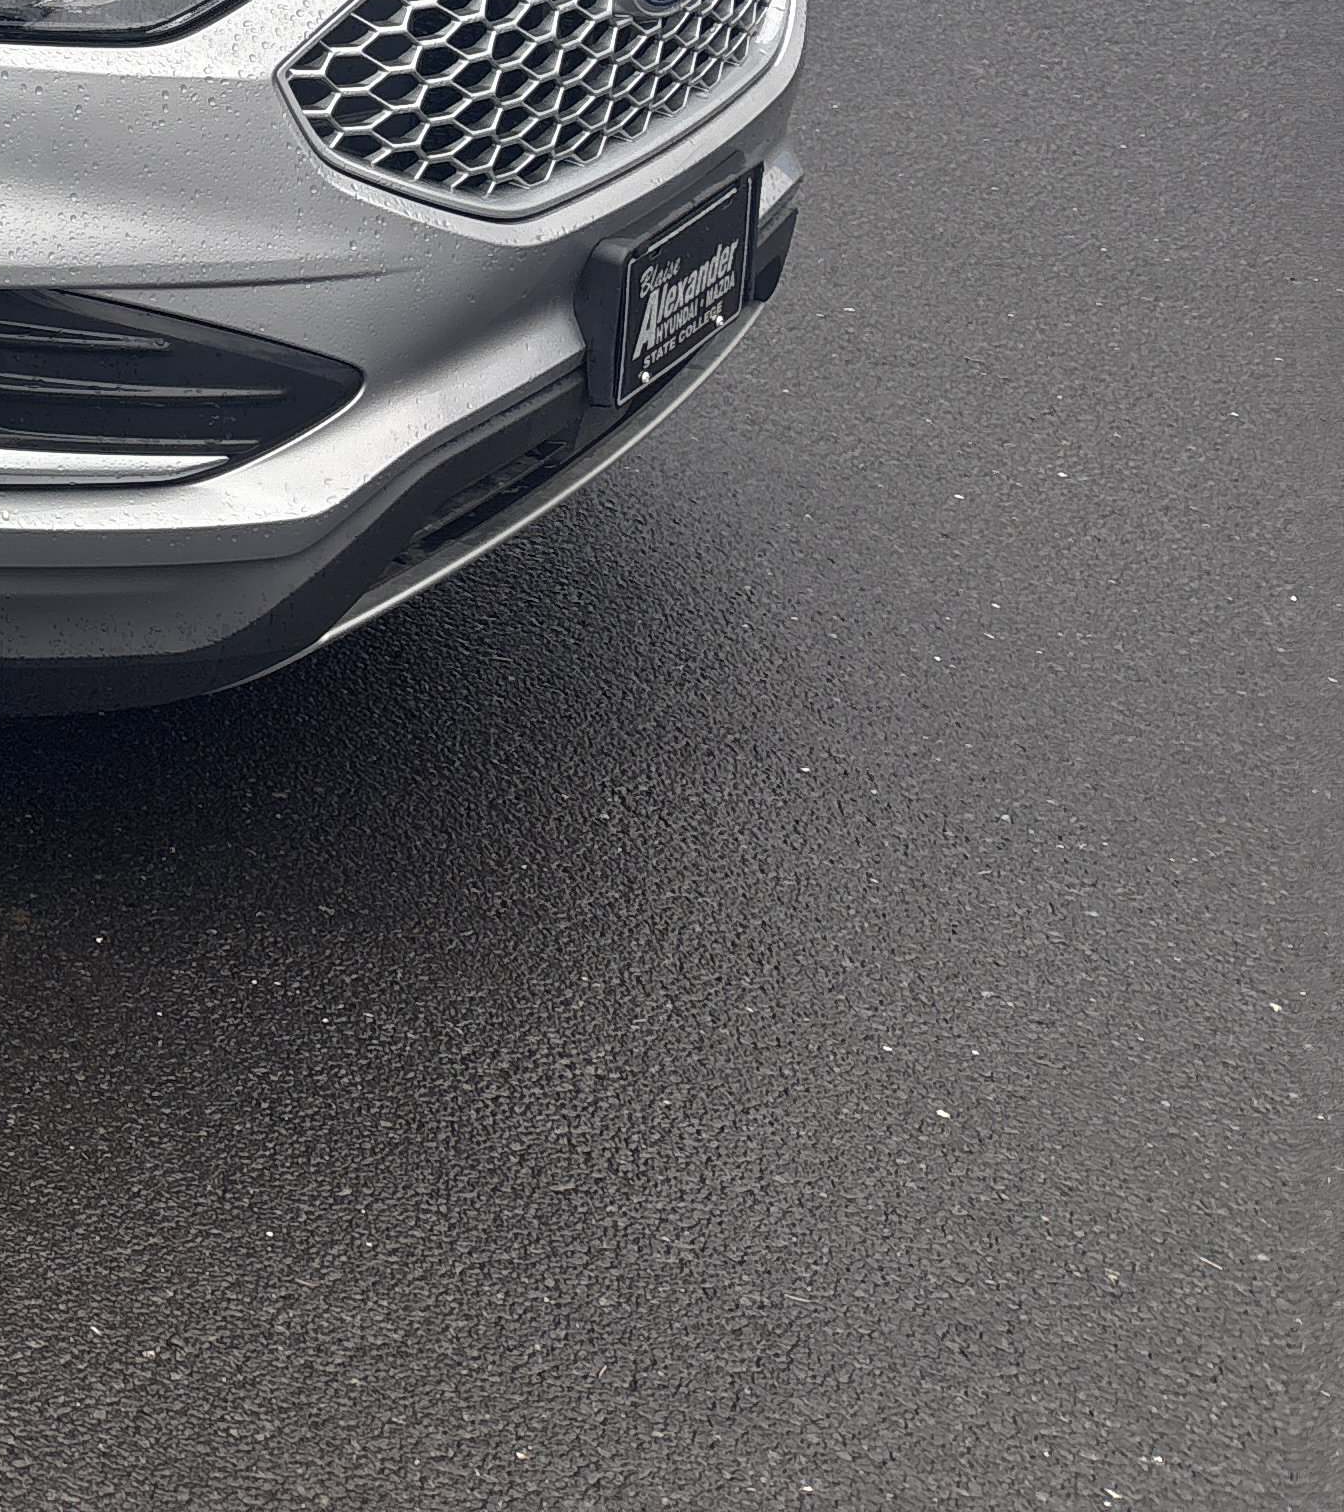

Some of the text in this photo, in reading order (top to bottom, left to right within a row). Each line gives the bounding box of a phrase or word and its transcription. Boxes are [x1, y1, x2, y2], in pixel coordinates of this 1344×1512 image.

[632, 238, 739, 361] Alexander
[639, 257, 681, 299] Blaise
[655, 270, 736, 345] HYUNDAI MAZDA
[643, 301, 723, 369] STATE COLLEGE
